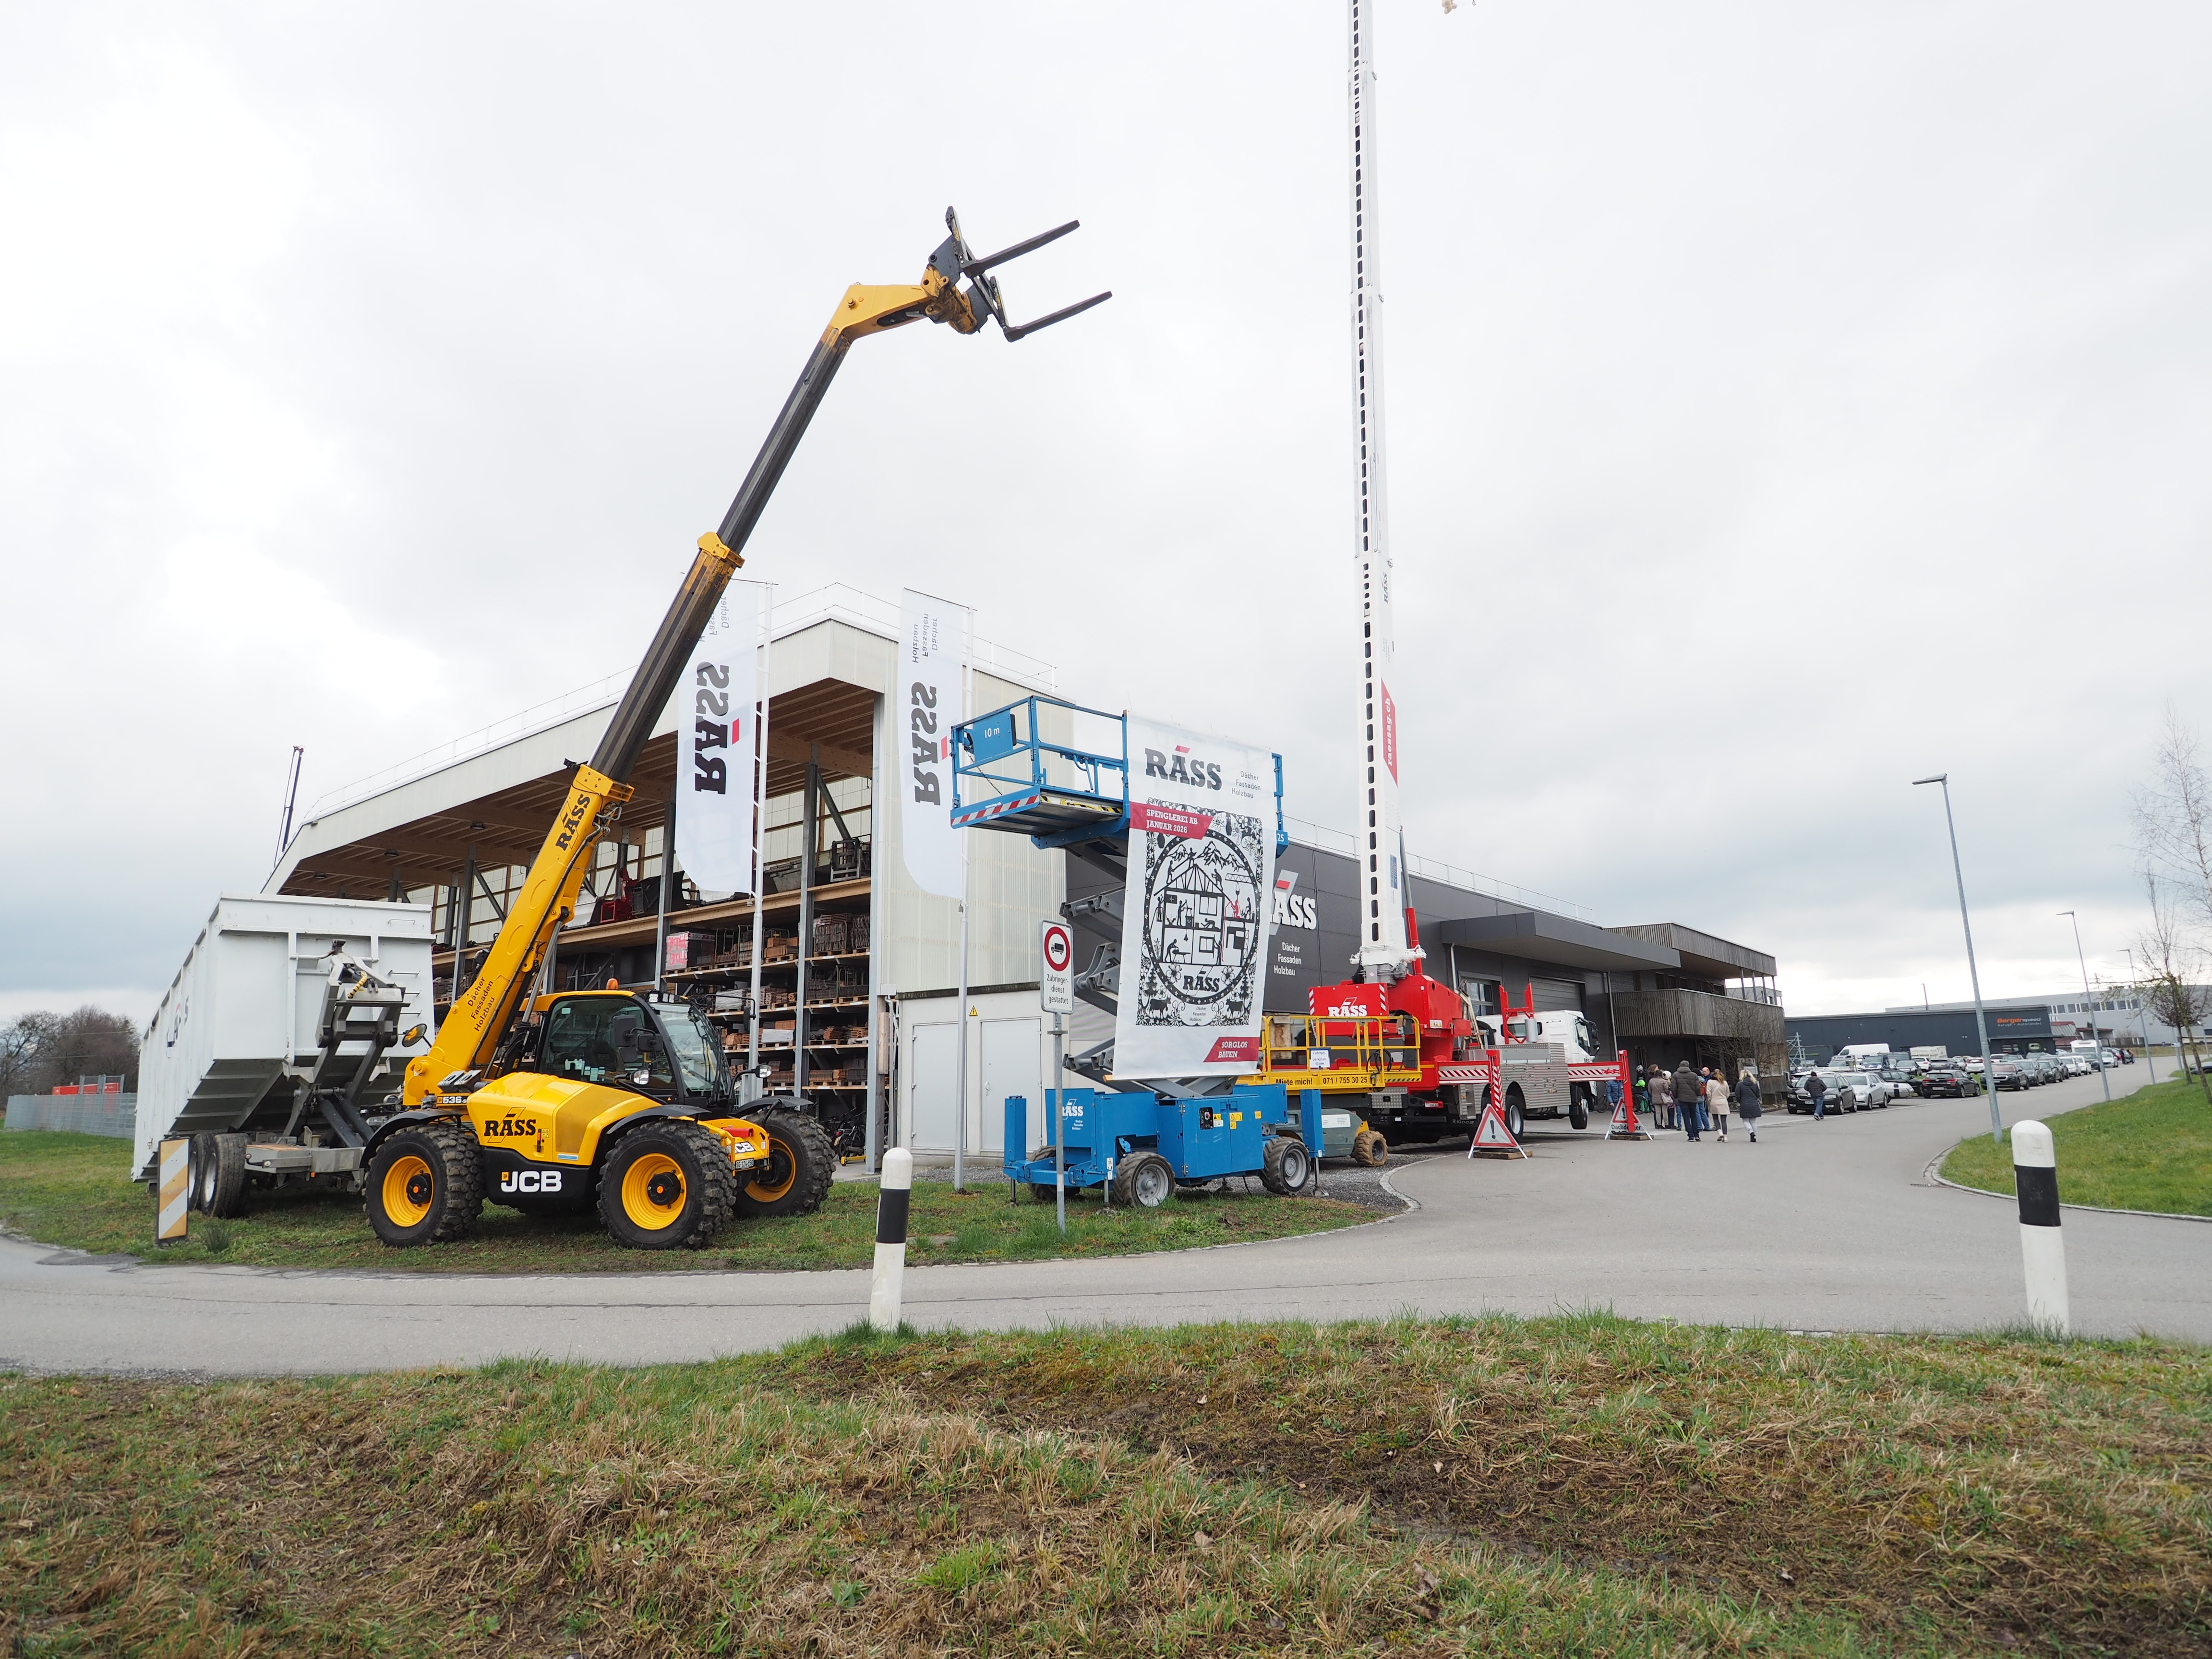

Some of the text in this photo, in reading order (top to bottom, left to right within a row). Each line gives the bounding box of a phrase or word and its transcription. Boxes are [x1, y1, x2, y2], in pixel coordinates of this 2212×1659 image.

[985, 728, 992, 739] 10
[1144, 745, 1222, 791] RÄSS
[1240, 770, 1259, 781] Dächer
[1236, 779, 1261, 791] Fassaden
[1231, 788, 1254, 799] Holzbau
[555, 793, 590, 851] RÄSS
[1146, 808, 1198, 825] SPENGLEREI AB
[1146, 819, 1188, 833] JANUAR 2026
[1270, 879, 1317, 930] ÄSS
[1282, 942, 1300, 953] Dächer
[1278, 953, 1302, 965] Fassaden
[1274, 965, 1296, 976] Holzbau
[1047, 974, 1069, 986] Zubringer-
[1182, 971, 1220, 992] RÄSS
[468, 977, 485, 1007] Dächer
[1051, 985, 1064, 994] dienst
[471, 981, 493, 1019] Fassaden
[1048, 996, 1068, 1004] gestattet
[474, 997, 495, 1032] Holzbau
[1328, 1001, 1368, 1017] RÄSS
[484, 1113, 536, 1137] RÄSS
[734, 1142, 755, 1154] CB
[501, 1171, 562, 1192] JCB
